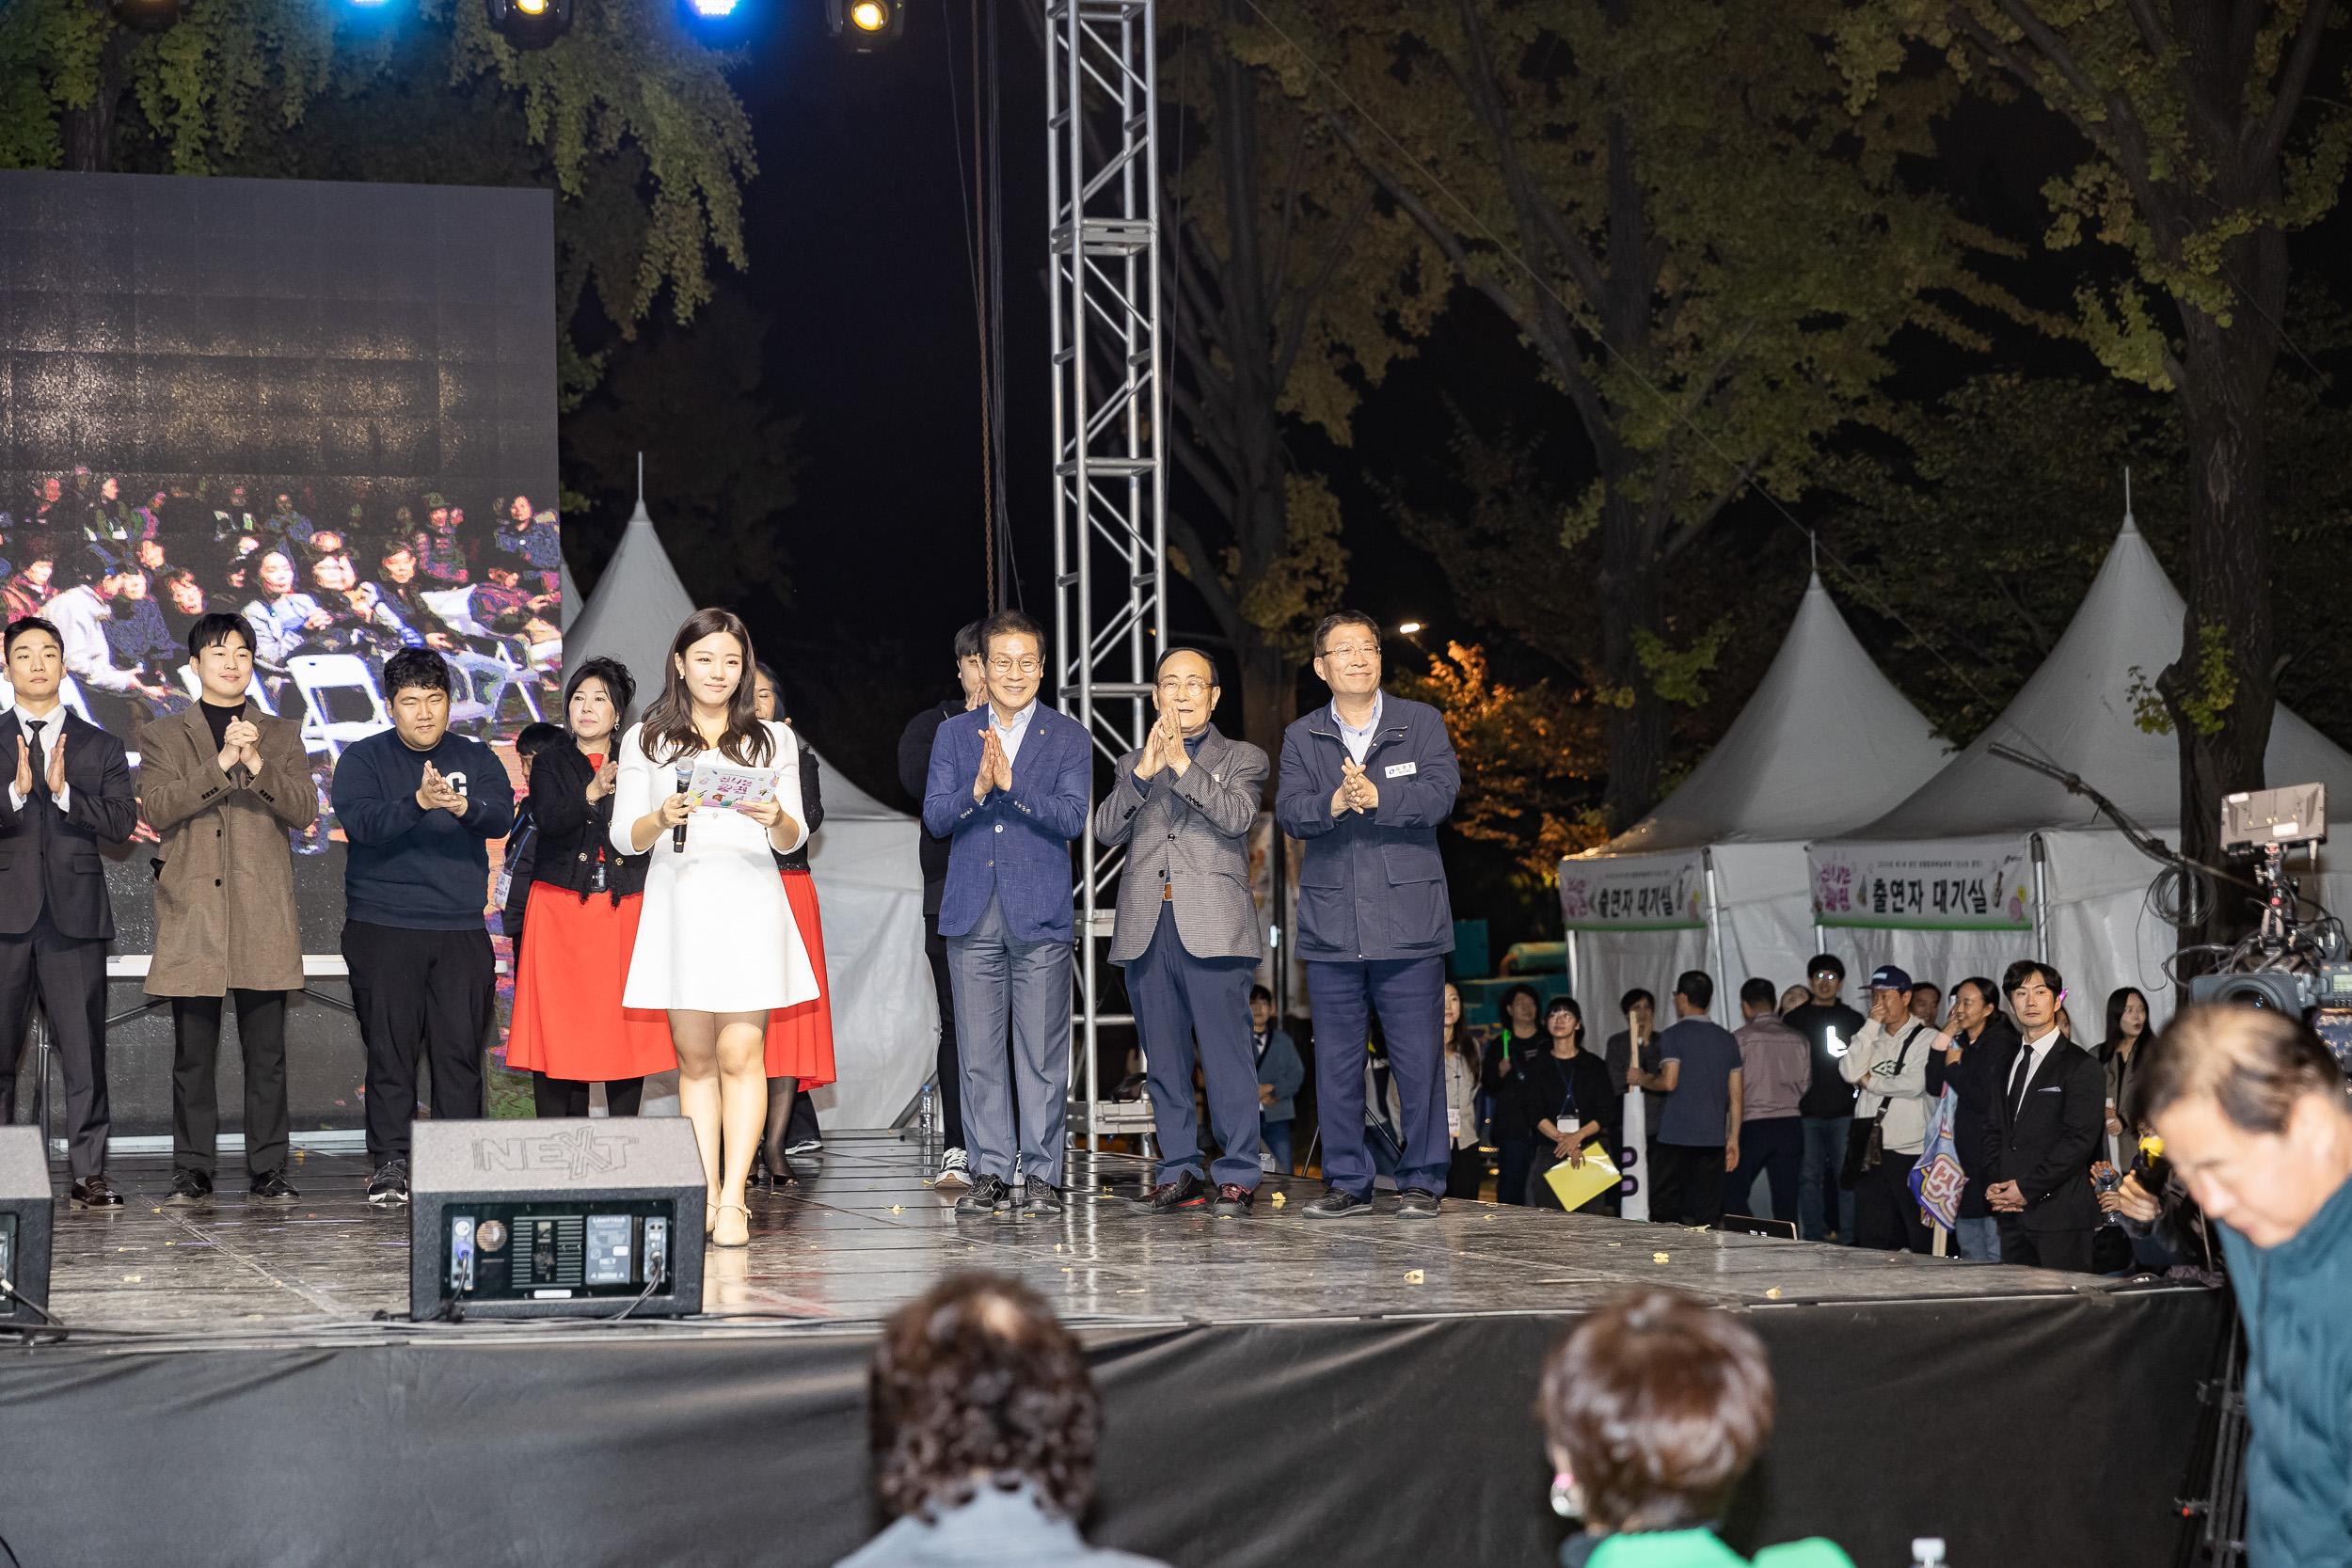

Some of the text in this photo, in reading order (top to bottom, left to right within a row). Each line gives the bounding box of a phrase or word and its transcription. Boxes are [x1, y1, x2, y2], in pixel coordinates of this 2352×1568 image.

[445, 771, 468, 797] C
[1637, 884, 1674, 917] 대기실
[1872, 878, 1988, 914] 출연자 대기실
[473, 1126, 629, 1180] NEXT
